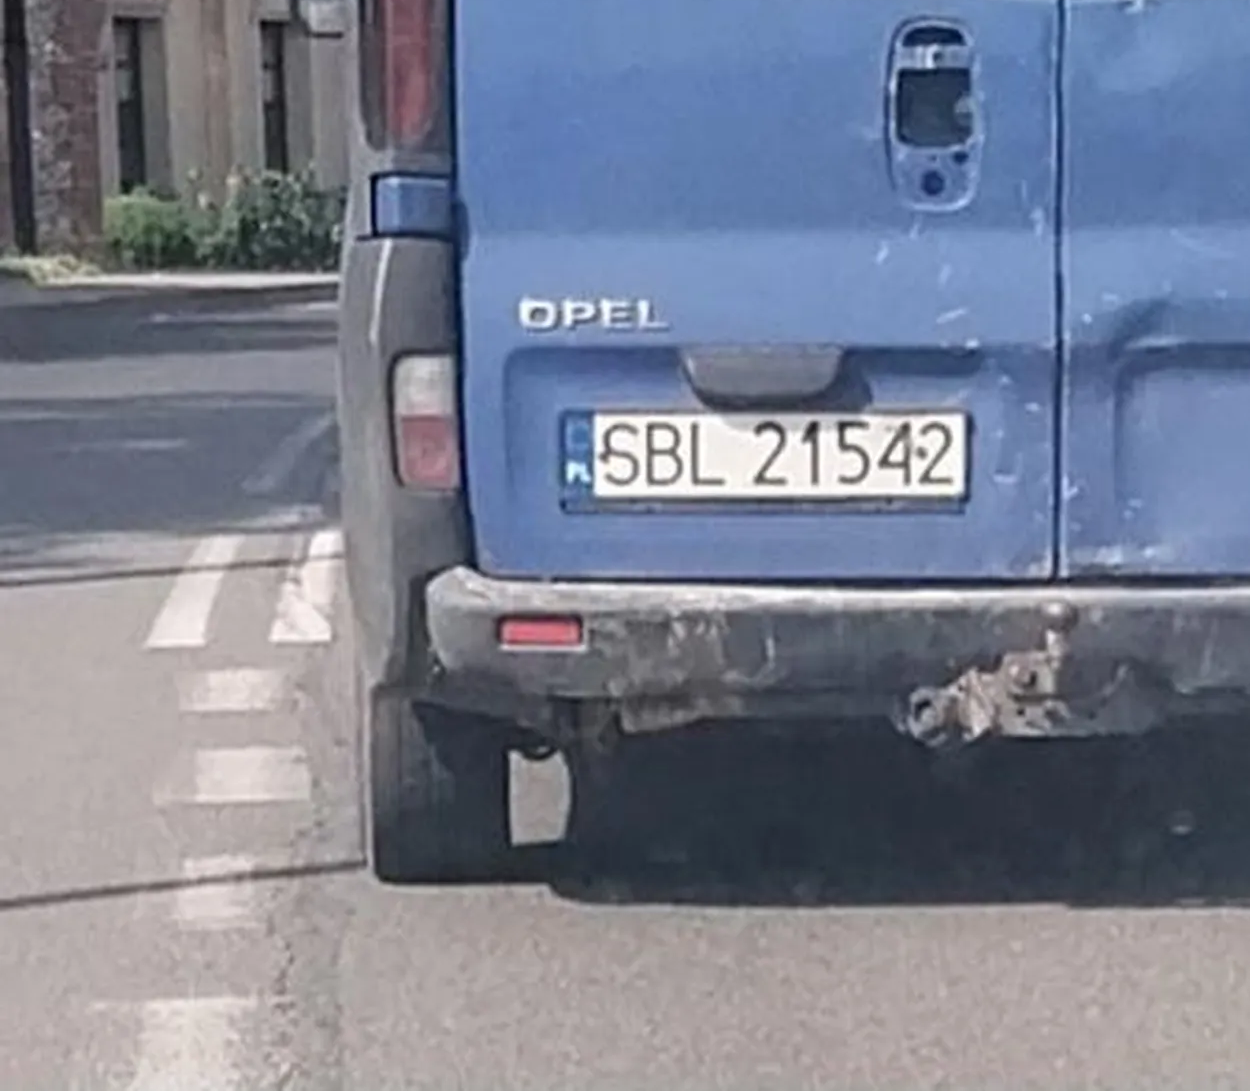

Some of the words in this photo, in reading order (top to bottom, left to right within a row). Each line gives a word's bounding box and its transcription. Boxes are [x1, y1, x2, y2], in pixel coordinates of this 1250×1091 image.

[518, 297, 668, 331] OPEL
[602, 421, 726, 487] SBL
[753, 420, 955, 486] 21542
